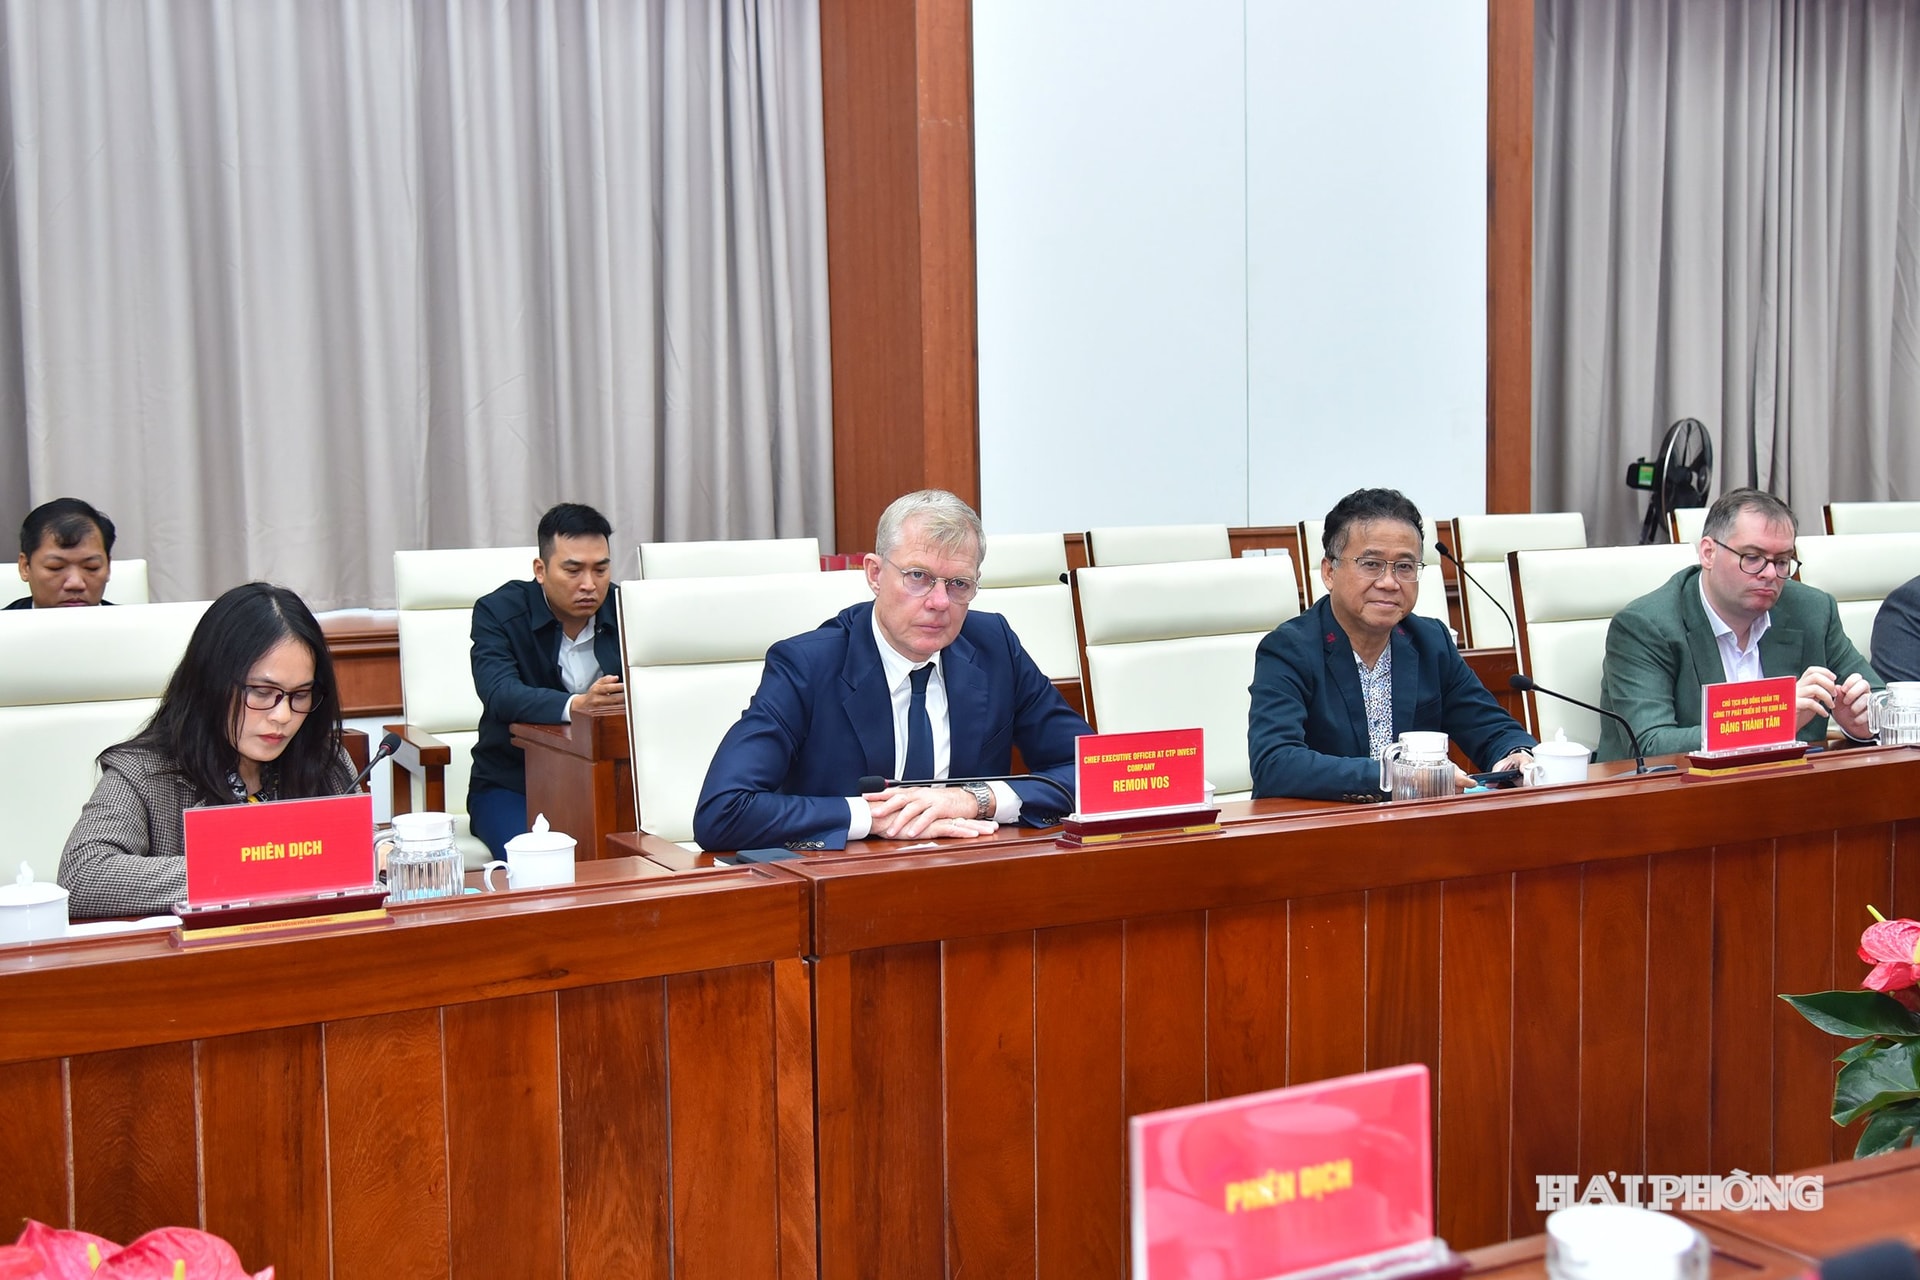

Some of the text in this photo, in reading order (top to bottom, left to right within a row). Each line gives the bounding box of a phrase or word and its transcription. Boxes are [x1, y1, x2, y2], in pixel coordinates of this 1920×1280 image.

[1720, 720, 1740, 736] ĐẶNG
[1765, 715, 1780, 728] TÂM
[1084, 747, 1197, 764] CHIEF EXECUTIVE OFFICER AT CTP INVEST
[1127, 762, 1155, 772] COMPANY
[1113, 776, 1169, 792] REMON VOS
[241, 839, 322, 862] PHIÊN DỊCH
[1226, 1158, 1353, 1215] PHIÊN DỊCH
